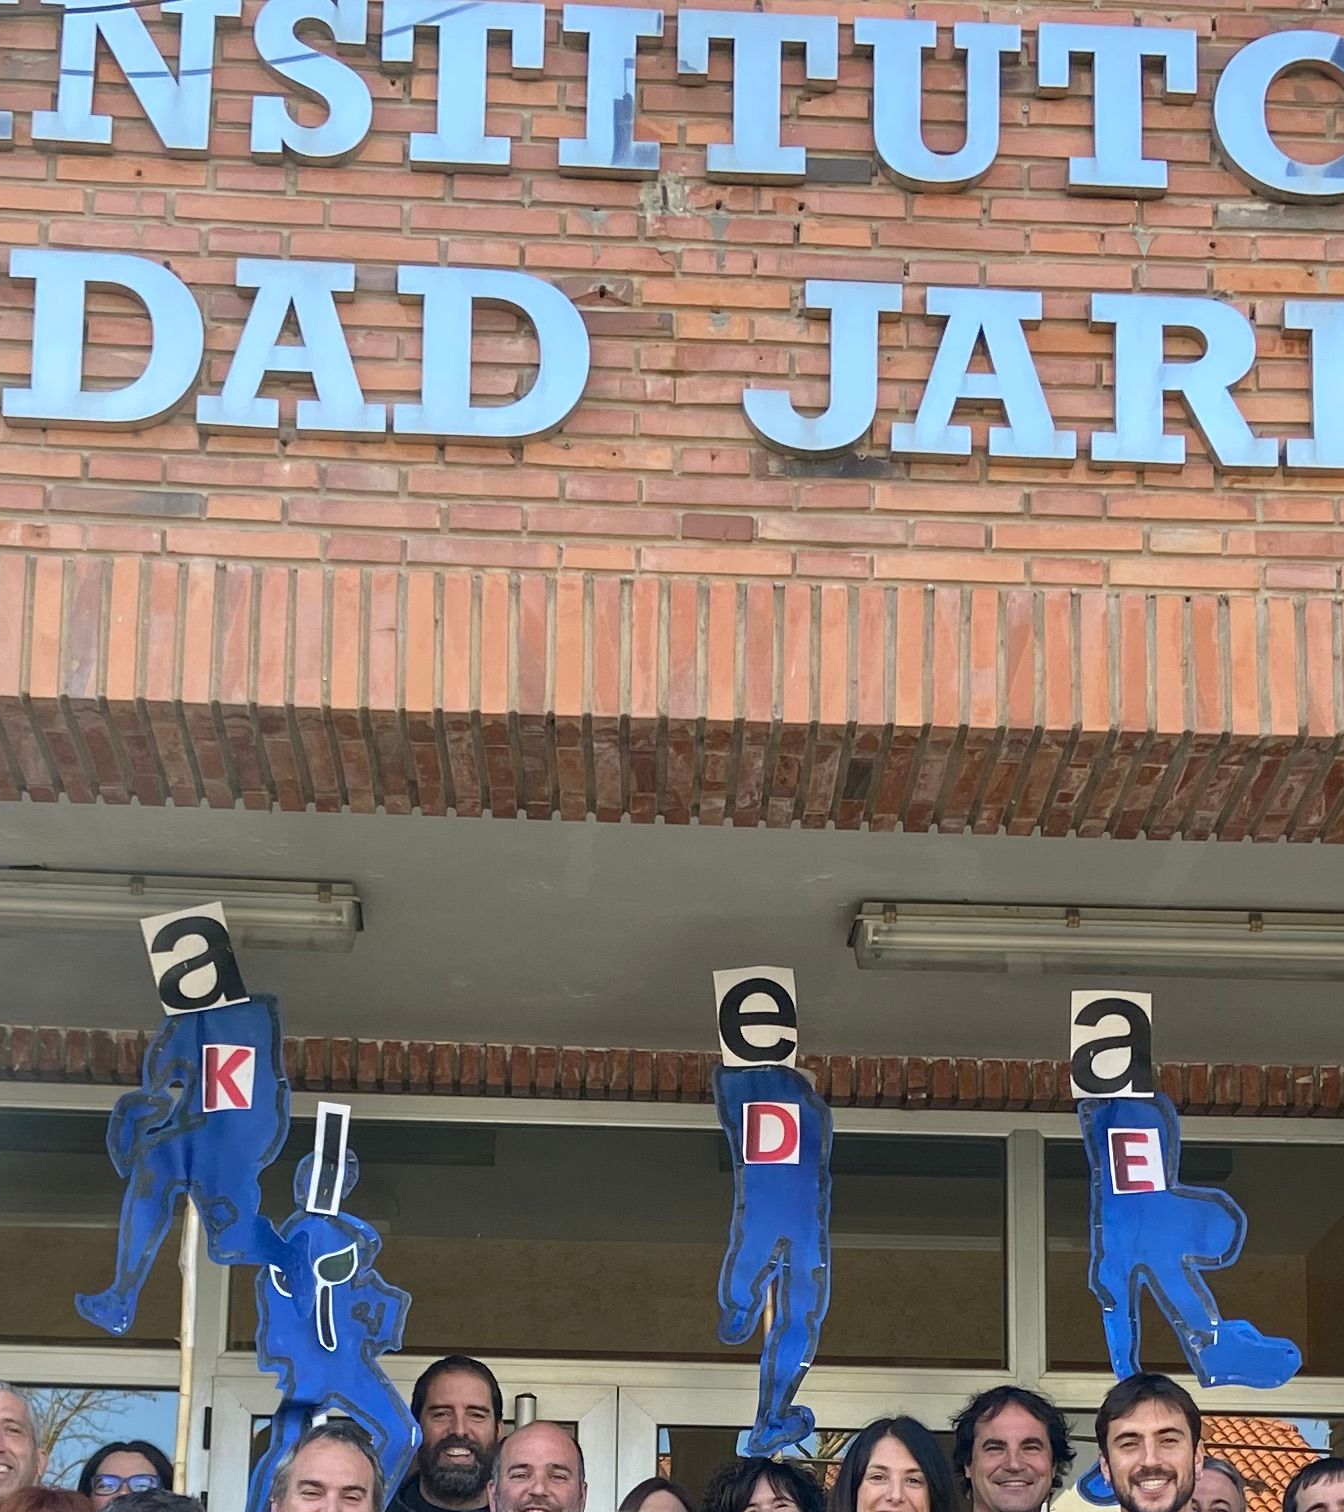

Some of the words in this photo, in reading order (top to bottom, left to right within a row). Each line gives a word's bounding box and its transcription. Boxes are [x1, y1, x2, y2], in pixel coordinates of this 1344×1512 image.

[150, 914, 249, 1012] a
[718, 977, 796, 1063] e
[1073, 998, 1152, 1096] a
[746, 1107, 798, 1164] D
[1110, 1131, 1158, 1192] E
